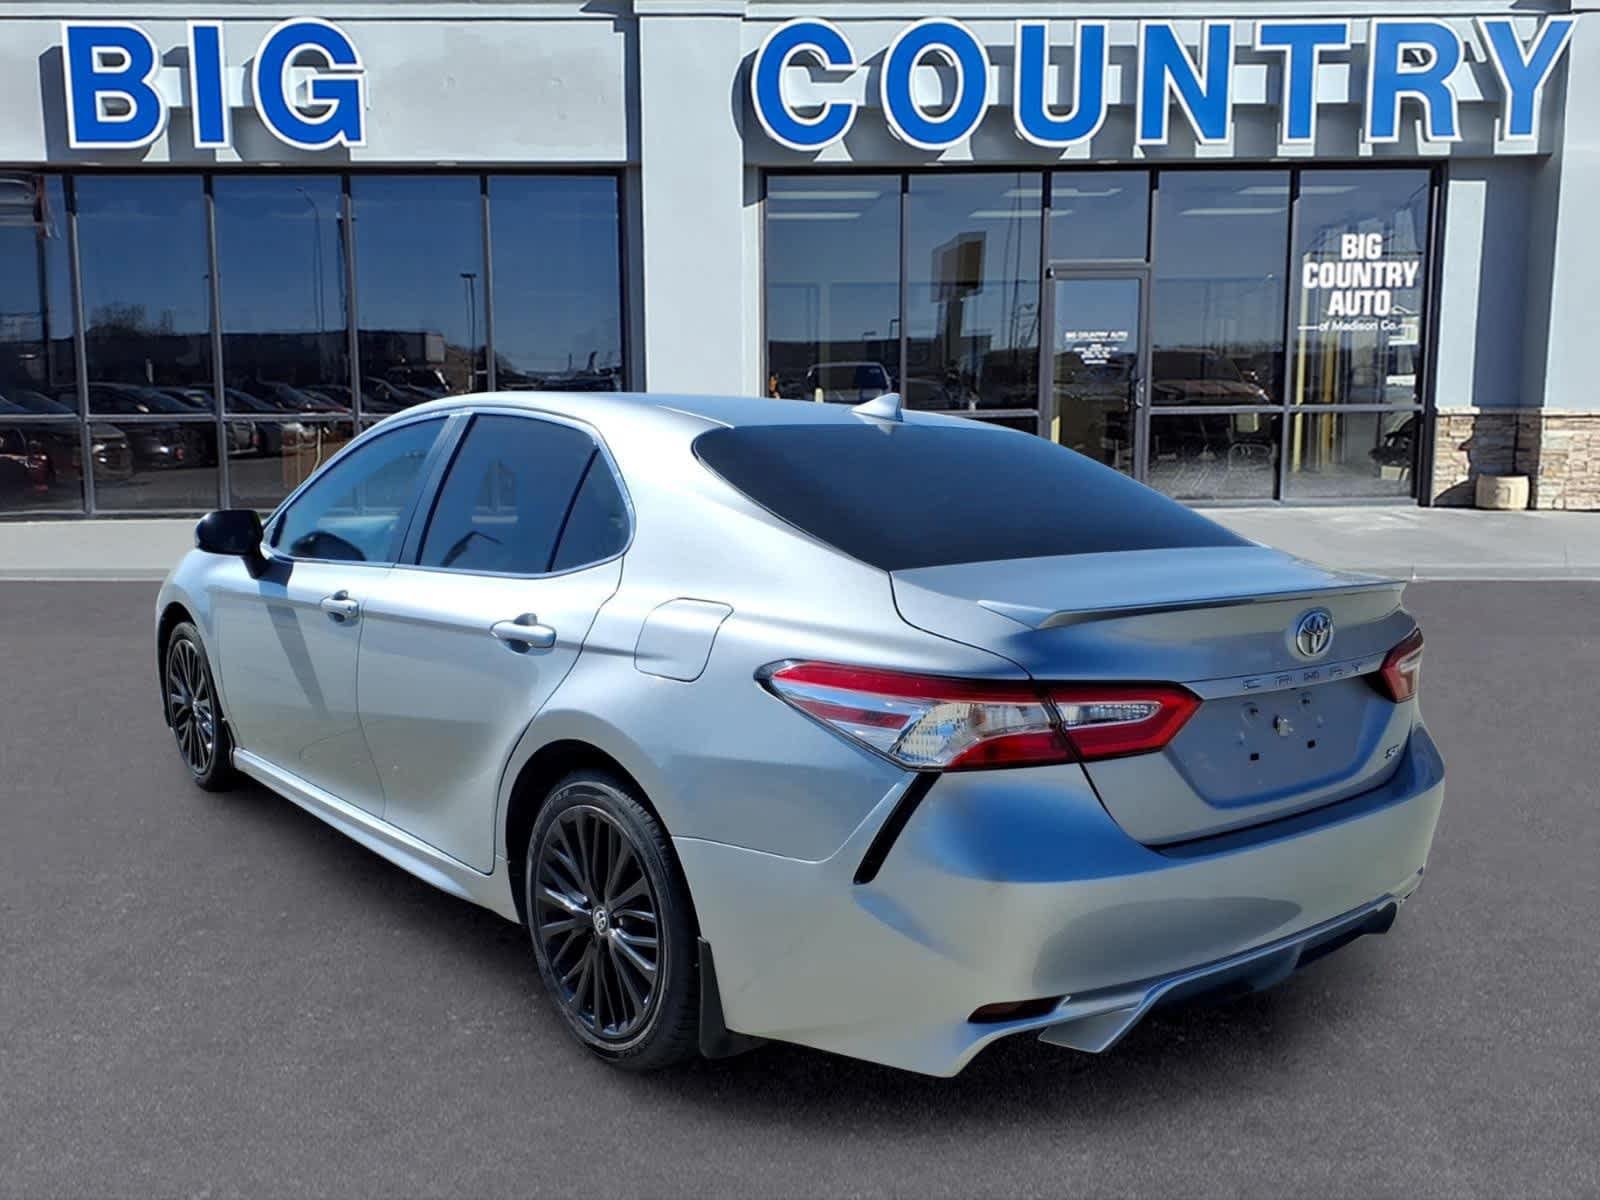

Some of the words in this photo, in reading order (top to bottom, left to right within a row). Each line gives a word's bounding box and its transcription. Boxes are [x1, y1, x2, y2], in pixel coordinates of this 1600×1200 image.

[61, 17, 368, 151] BIG
[751, 14, 1575, 152] COUNTRY
[1341, 233, 1383, 260] BIG
[1302, 260, 1420, 289] COUNTRY
[1327, 290, 1392, 317] AUTO
[1319, 321, 1329, 332] of
[1331, 321, 1378, 331] Madison
